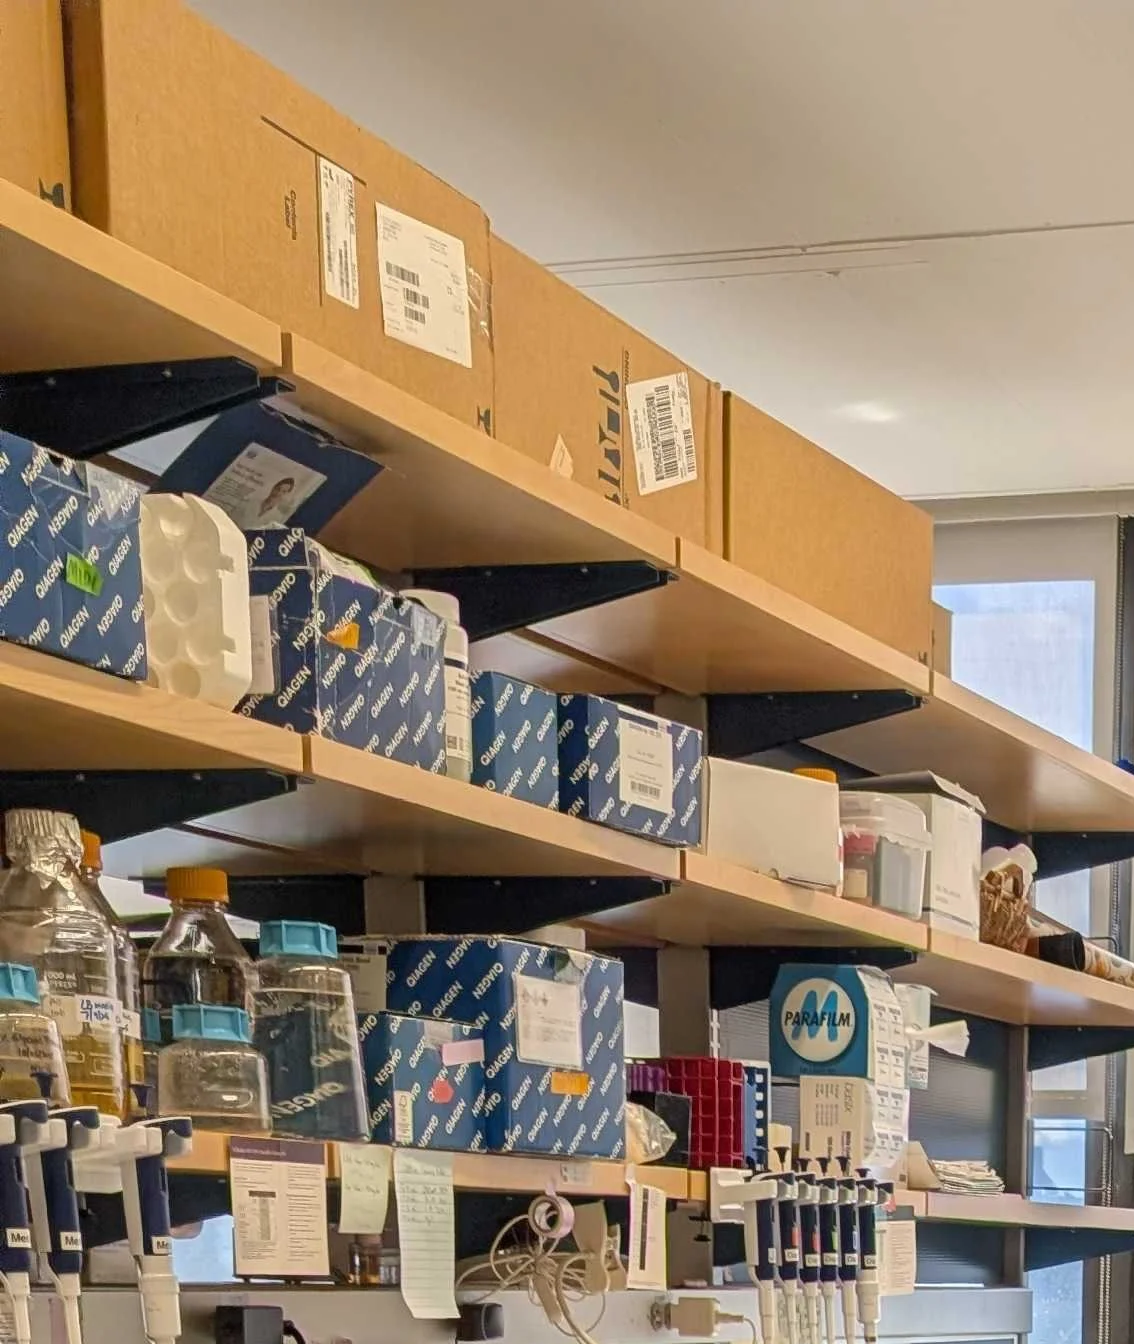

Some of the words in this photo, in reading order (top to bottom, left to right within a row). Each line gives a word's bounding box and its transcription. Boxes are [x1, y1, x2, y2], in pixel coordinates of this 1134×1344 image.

[8, 504, 39, 548] QIAGEN
[48, 495, 79, 538] QIAGEN
[109, 534, 132, 576] QIAGEN
[35, 555, 64, 599] QIAGEN
[60, 606, 90, 648] QIAGEN
[97, 595, 123, 637] QIAGEN
[355, 642, 379, 678] QIAGEN
[384, 632, 405, 667] QIAGEN
[277, 665, 311, 708] QIAGEN
[322, 653, 347, 689] QIAGEN
[371, 682, 394, 719] QIAGEN
[399, 672, 419, 708] QIAGEN
[495, 683, 513, 717] QIAGEN
[341, 694, 365, 731] QIAGEN
[413, 712, 432, 746] QIAGEN
[537, 709, 555, 741] QIAGEN
[385, 722, 409, 758] QIAGEN
[481, 730, 506, 766] QIAGEN
[512, 720, 531, 753] QIAGEN
[588, 717, 609, 750] QIAGEN
[528, 756, 546, 789] QIAGEN
[681, 797, 698, 827] QIAGEN
[406, 950, 437, 987] QIAGEN
[472, 962, 504, 1000] QIAGEN
[433, 980, 464, 1017] QIAGEN
[784, 1011, 851, 1027] PARAFILM
[485, 1043, 515, 1079] QIAGEN
[586, 1032, 603, 1064] QIAGEN
[374, 1048, 402, 1086] QIAGEN
[601, 1062, 617, 1096] QIAGEN
[512, 1074, 532, 1110] QIAGEN
[445, 1098, 466, 1134] QIAGEN
[528, 1108, 548, 1142] QIAGEN
[553, 1094, 572, 1127] QIAGEN
[592, 1108, 610, 1140] QIAGEN
[568, 1123, 586, 1155] QIAGEN
